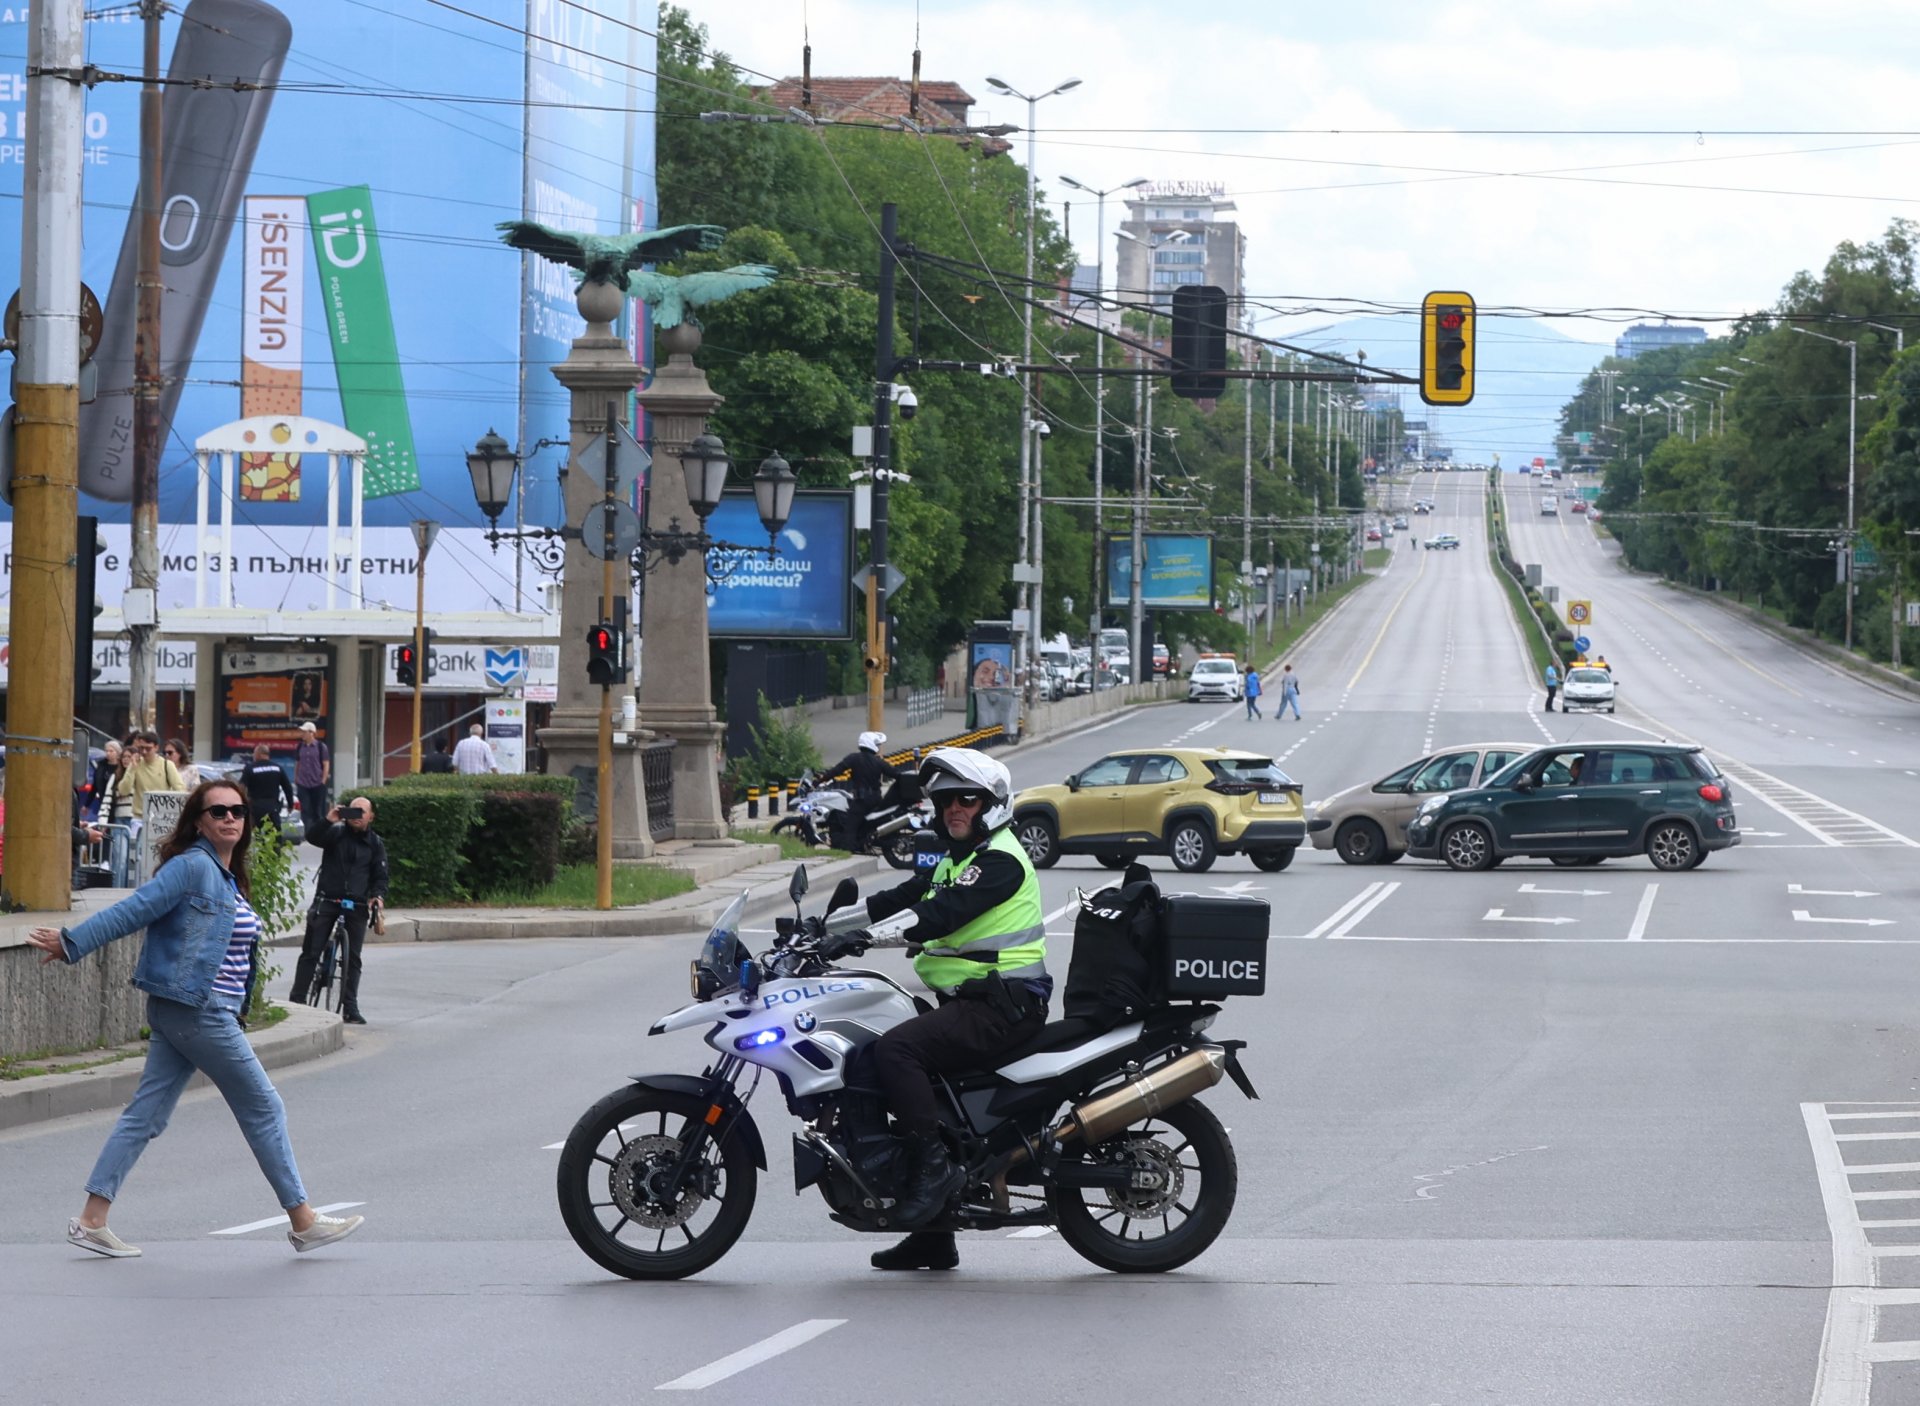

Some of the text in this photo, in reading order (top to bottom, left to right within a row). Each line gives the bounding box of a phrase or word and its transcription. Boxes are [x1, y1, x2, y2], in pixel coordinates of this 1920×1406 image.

[330, 276, 349, 344] POLAR GREEN
[100, 415, 133, 480] PULZE
[743, 556, 812, 574] правиш
[1175, 959, 1260, 980] POLICE
[763, 982, 865, 1010] POLICE
